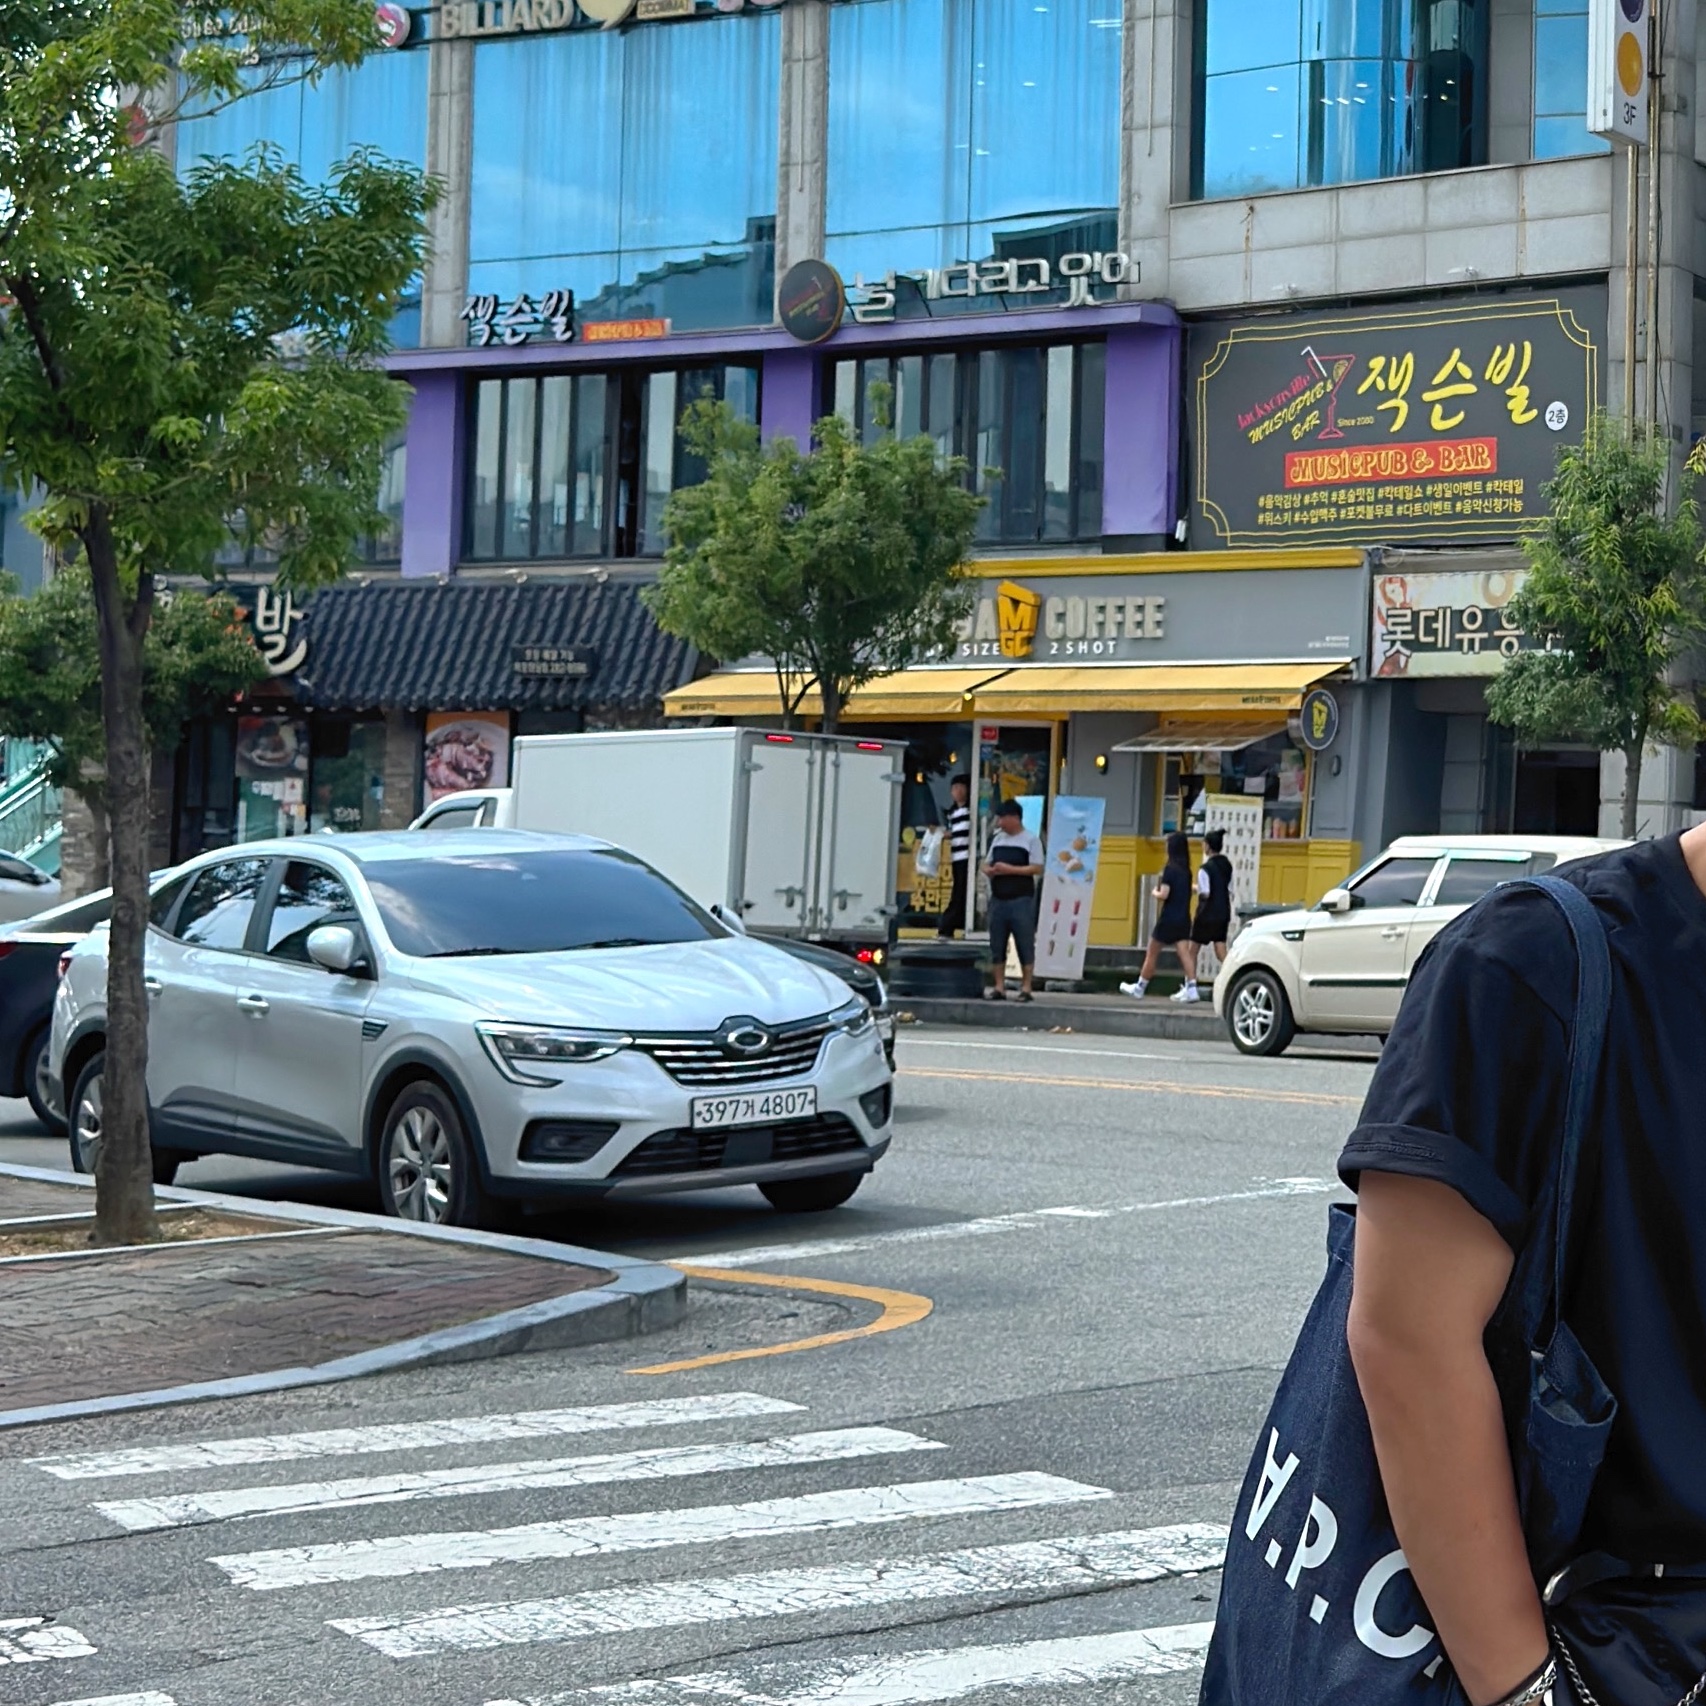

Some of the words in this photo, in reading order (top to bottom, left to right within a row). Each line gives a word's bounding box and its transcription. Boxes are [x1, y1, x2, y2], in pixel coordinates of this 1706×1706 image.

[441, 0, 574, 37] BILLIARD
[1623, 102, 1636, 125] 3F
[1357, 340, 1538, 432] 잭슨빌
[1548, 408, 1566, 424] 2층
[1291, 410, 1320, 440] BAR
[1290, 450, 1408, 482] MUSICPUB
[1410, 448, 1434, 474] &
[1440, 444, 1492, 473] BAR
[1045, 596, 1167, 639] COFFEE
[962, 642, 1001, 656] SIZE
[760, 1091, 808, 1116] 4807
